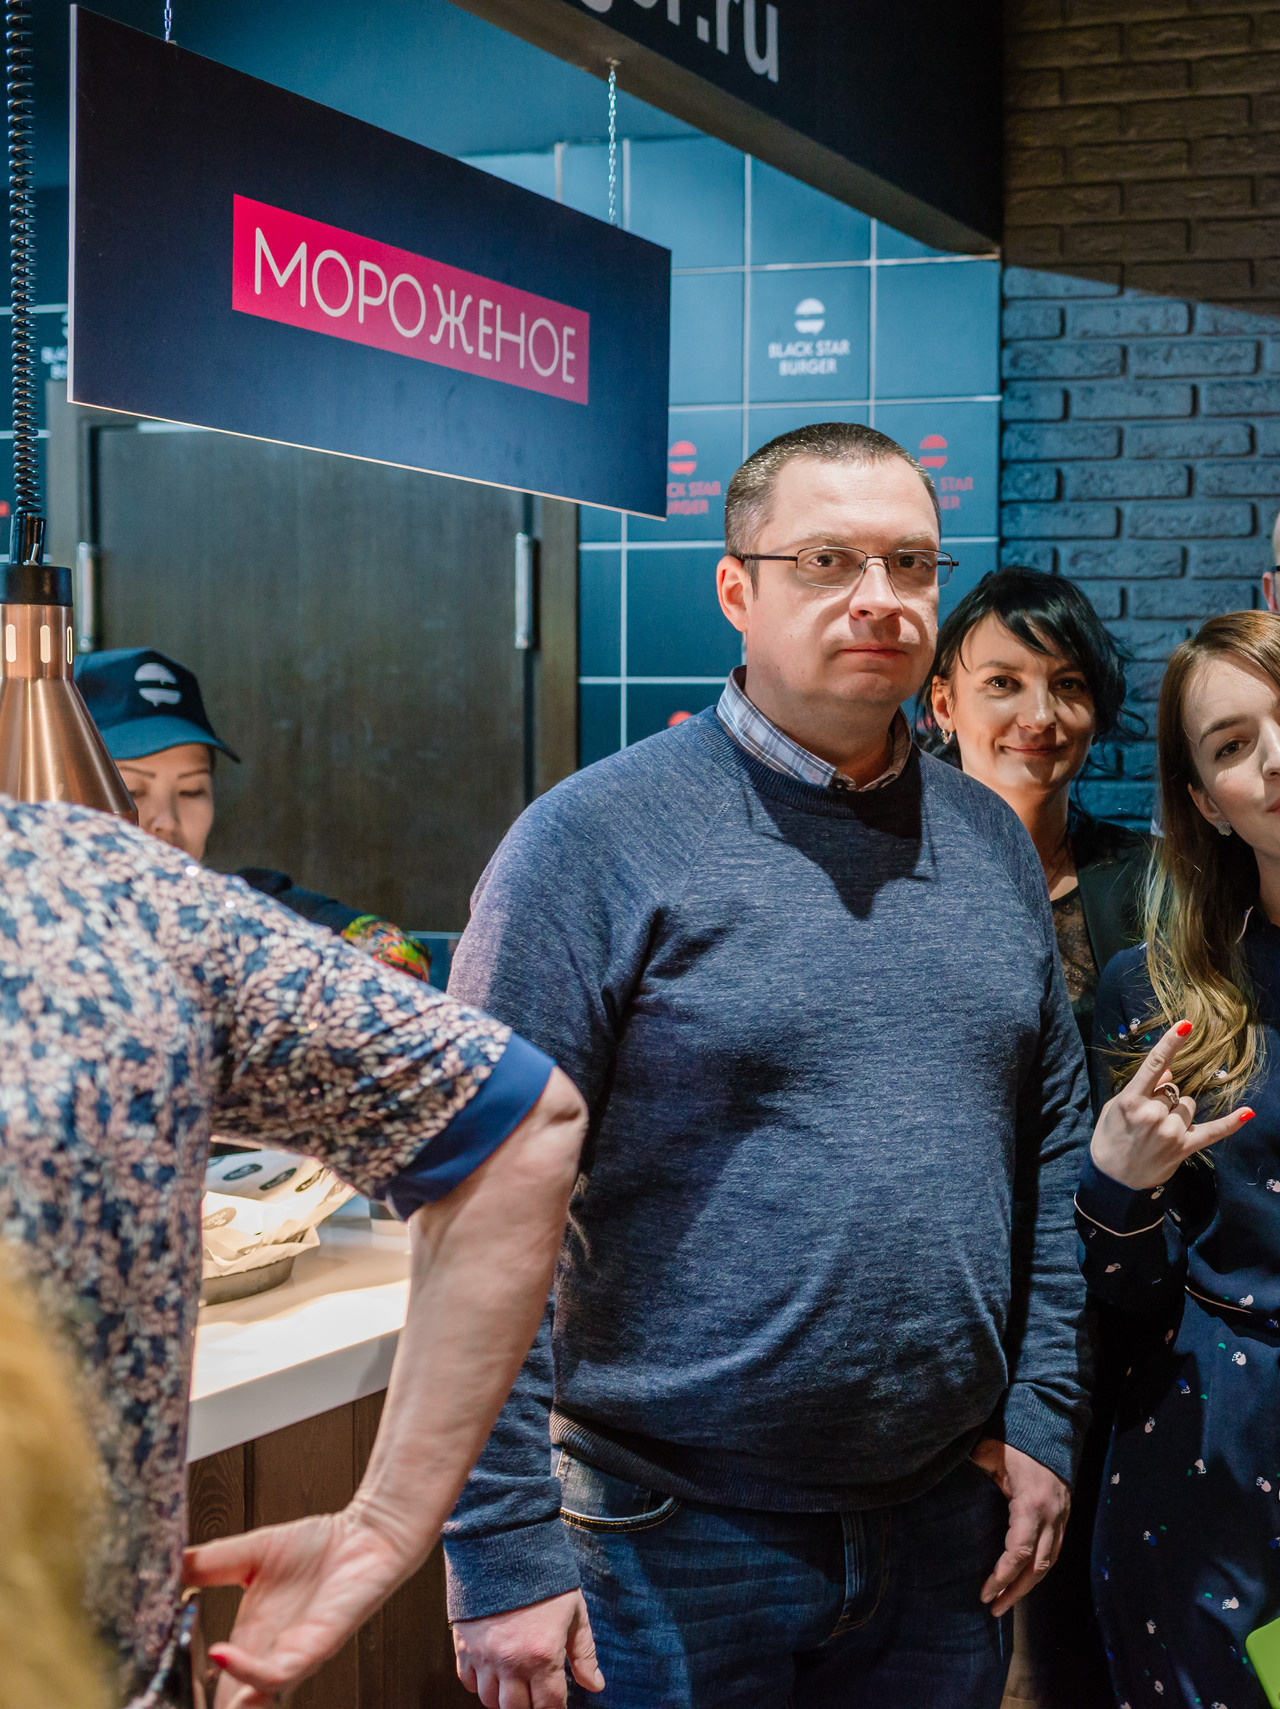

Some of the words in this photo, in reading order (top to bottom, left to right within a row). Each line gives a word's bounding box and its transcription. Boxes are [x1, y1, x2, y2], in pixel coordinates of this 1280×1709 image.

[254, 217, 576, 384] МОРОЖЕНОЕ
[768, 341, 814, 358] BLACK
[816, 339, 850, 356] STAR
[779, 358, 837, 376] BURGER
